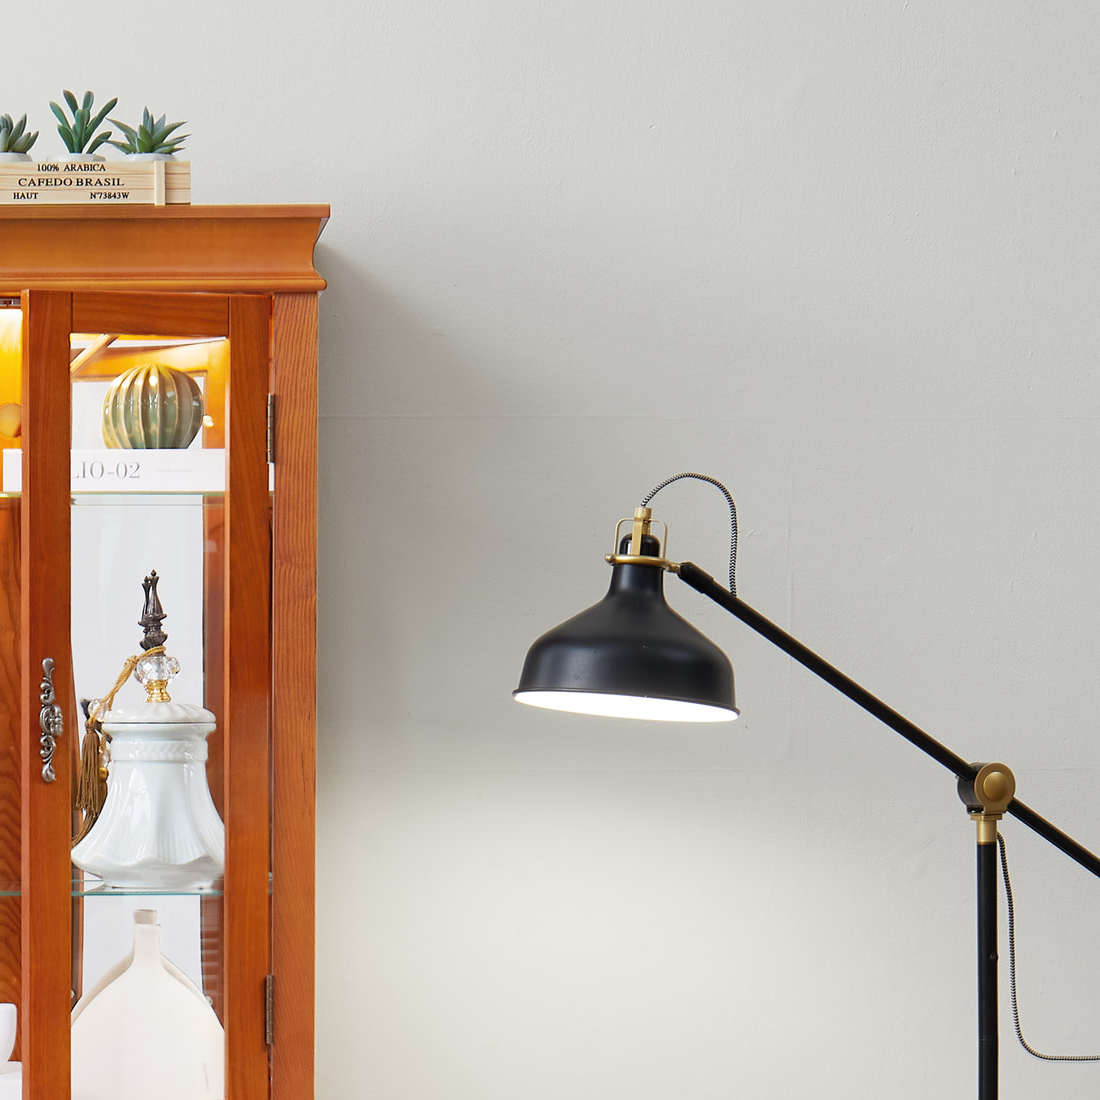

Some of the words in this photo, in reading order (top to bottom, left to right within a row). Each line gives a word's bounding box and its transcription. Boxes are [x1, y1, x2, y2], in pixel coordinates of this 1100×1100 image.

[37, 164, 59, 172] 100%
[63, 164, 106, 172] ARABICA
[18, 178, 73, 186] CAFEDO
[75, 178, 124, 186] BRASIL
[13, 192, 38, 200] HAUT
